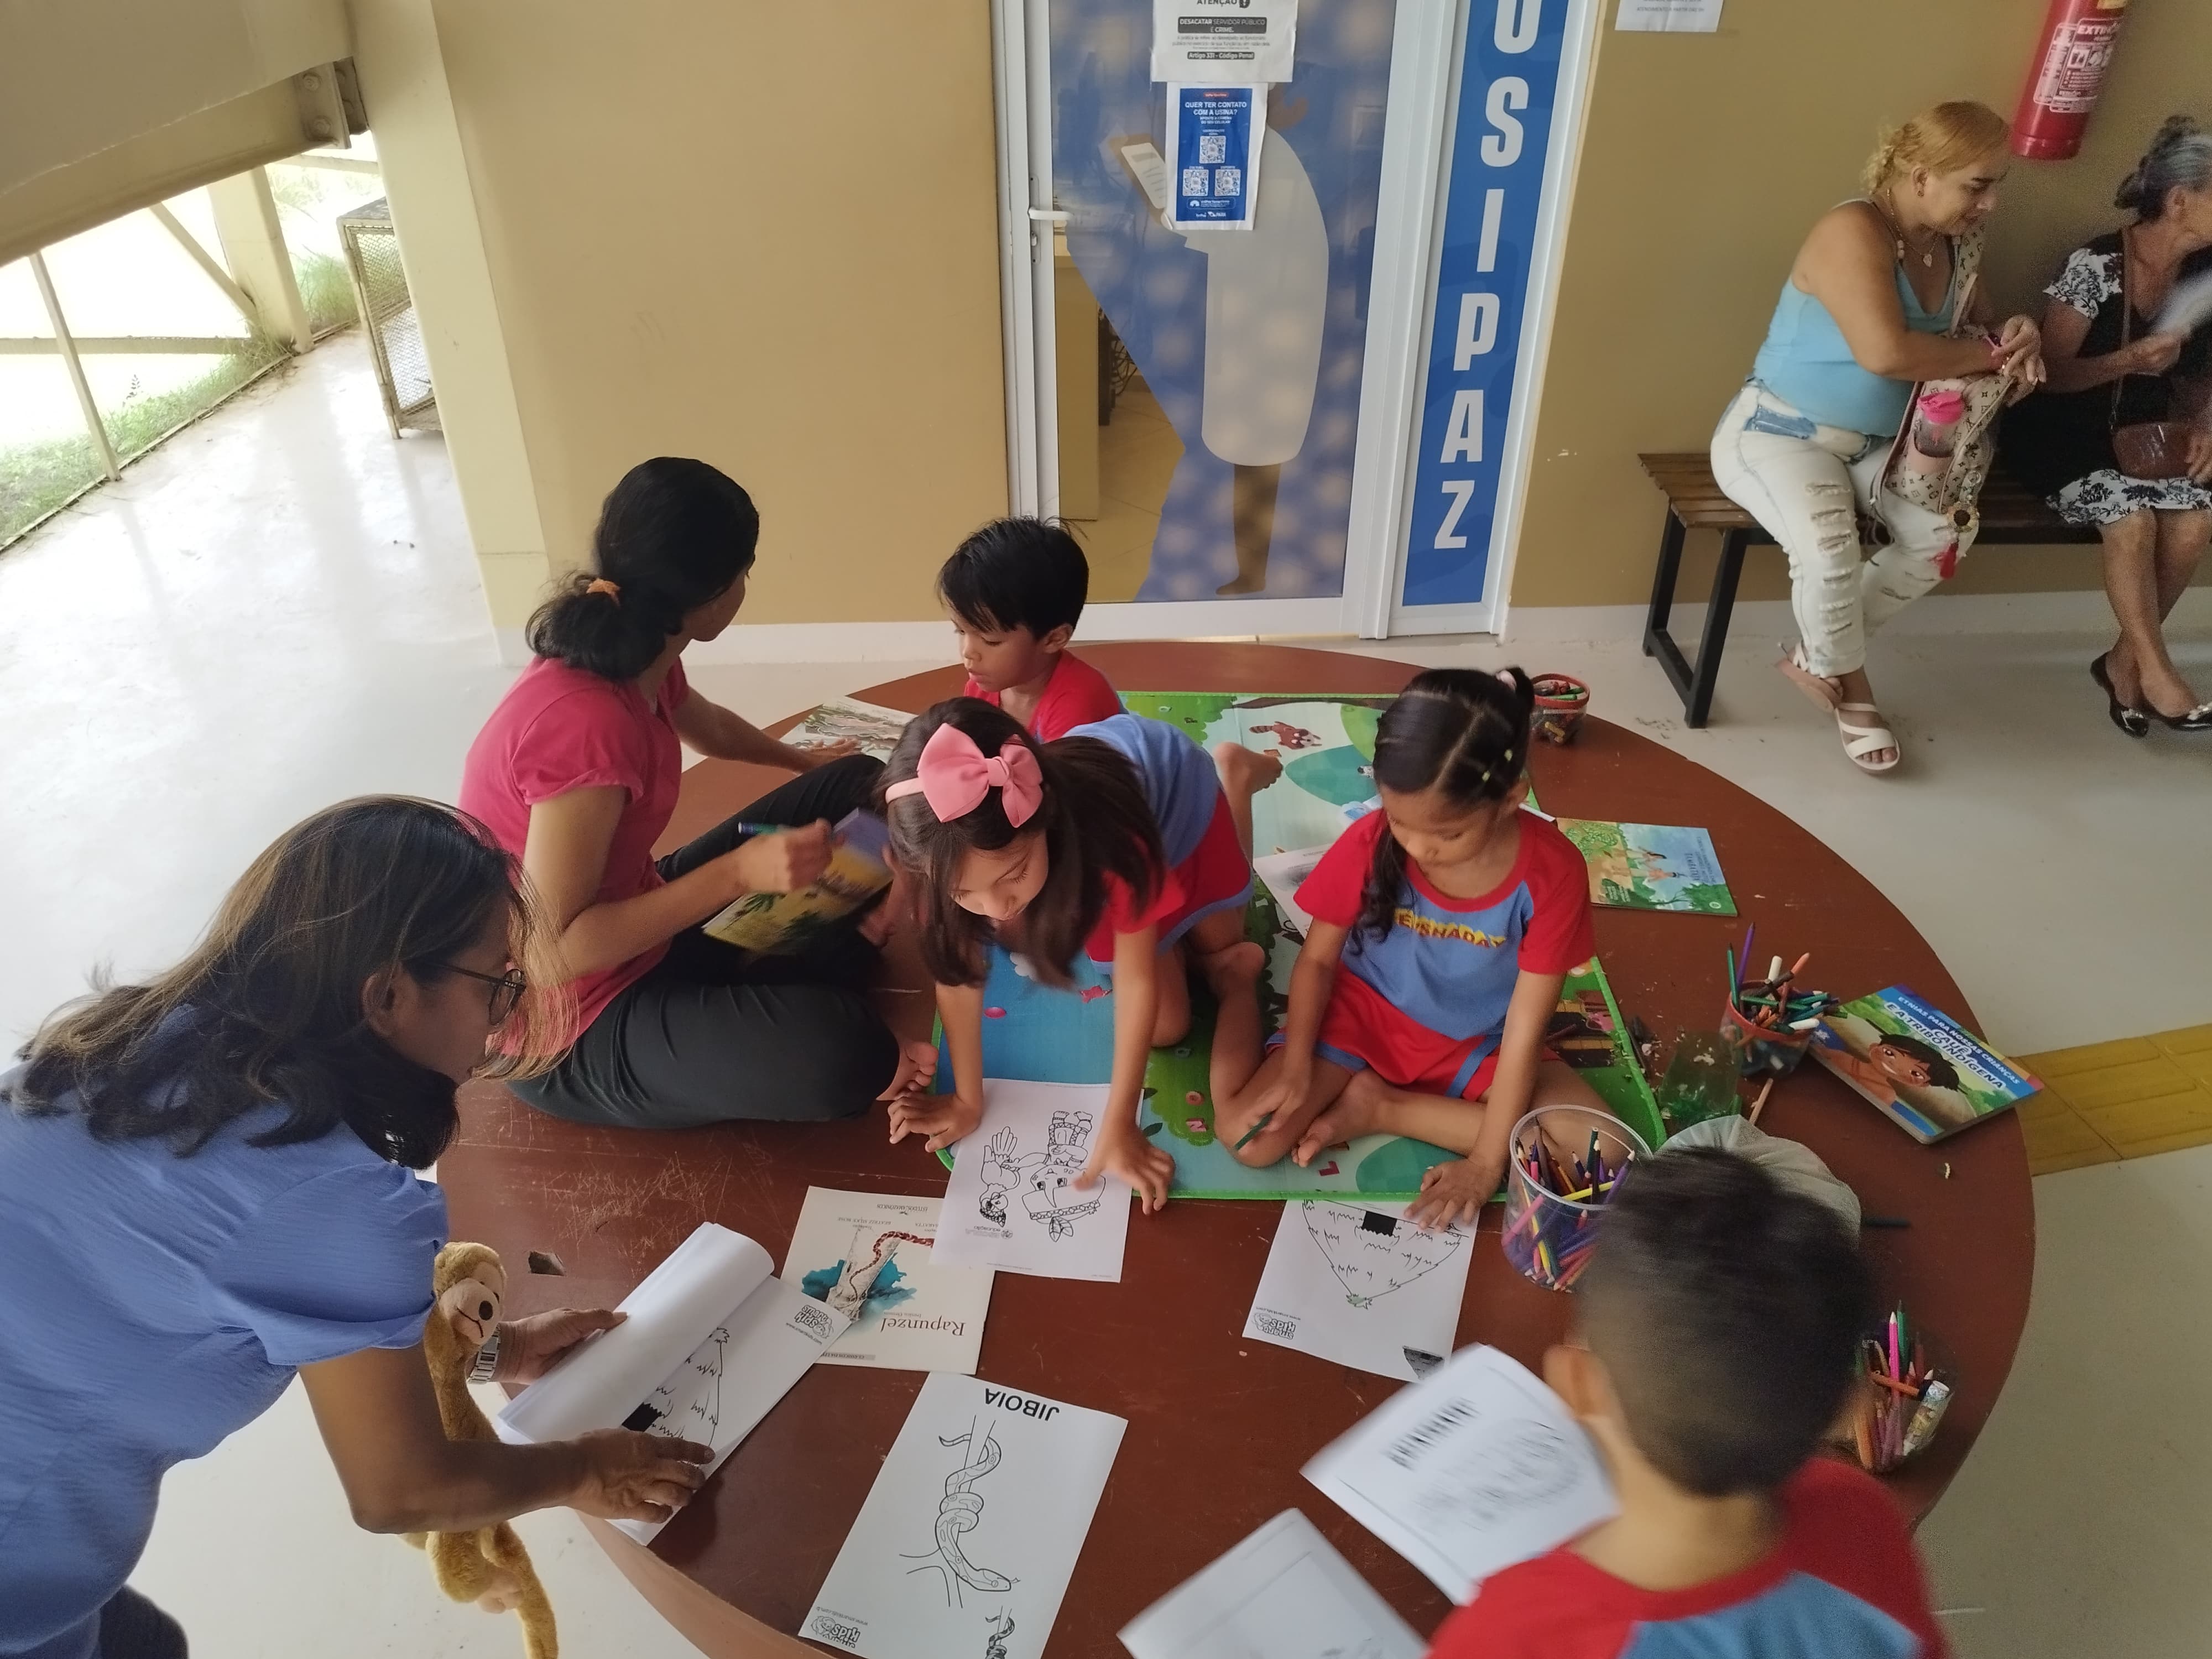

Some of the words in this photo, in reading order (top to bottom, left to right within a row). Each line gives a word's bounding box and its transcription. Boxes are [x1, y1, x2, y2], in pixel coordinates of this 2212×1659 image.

[2077, 25, 2117, 35] EXTIN
[1898, 996, 1929, 1018] ETNIAS
[1928, 1013, 1950, 1030] PARA
[1948, 1026, 1983, 1054] NOSSAS
[1980, 1049, 2021, 1085] CRIANÇAS
[1934, 1030, 1970, 1055] CAUÊ
[1907, 1016, 1943, 1046] TRIBO
[1942, 1041, 2004, 1089] INDÍGENA
[794, 1312, 820, 1329] kids
[802, 1305, 829, 1322] smart
[880, 1316, 966, 1336] Rapunzel
[1262, 1326, 1293, 1340] smart
[1270, 1318, 1296, 1333] kids
[984, 1387, 1060, 1422] JIBOIA
[831, 1623, 860, 1644] kids
